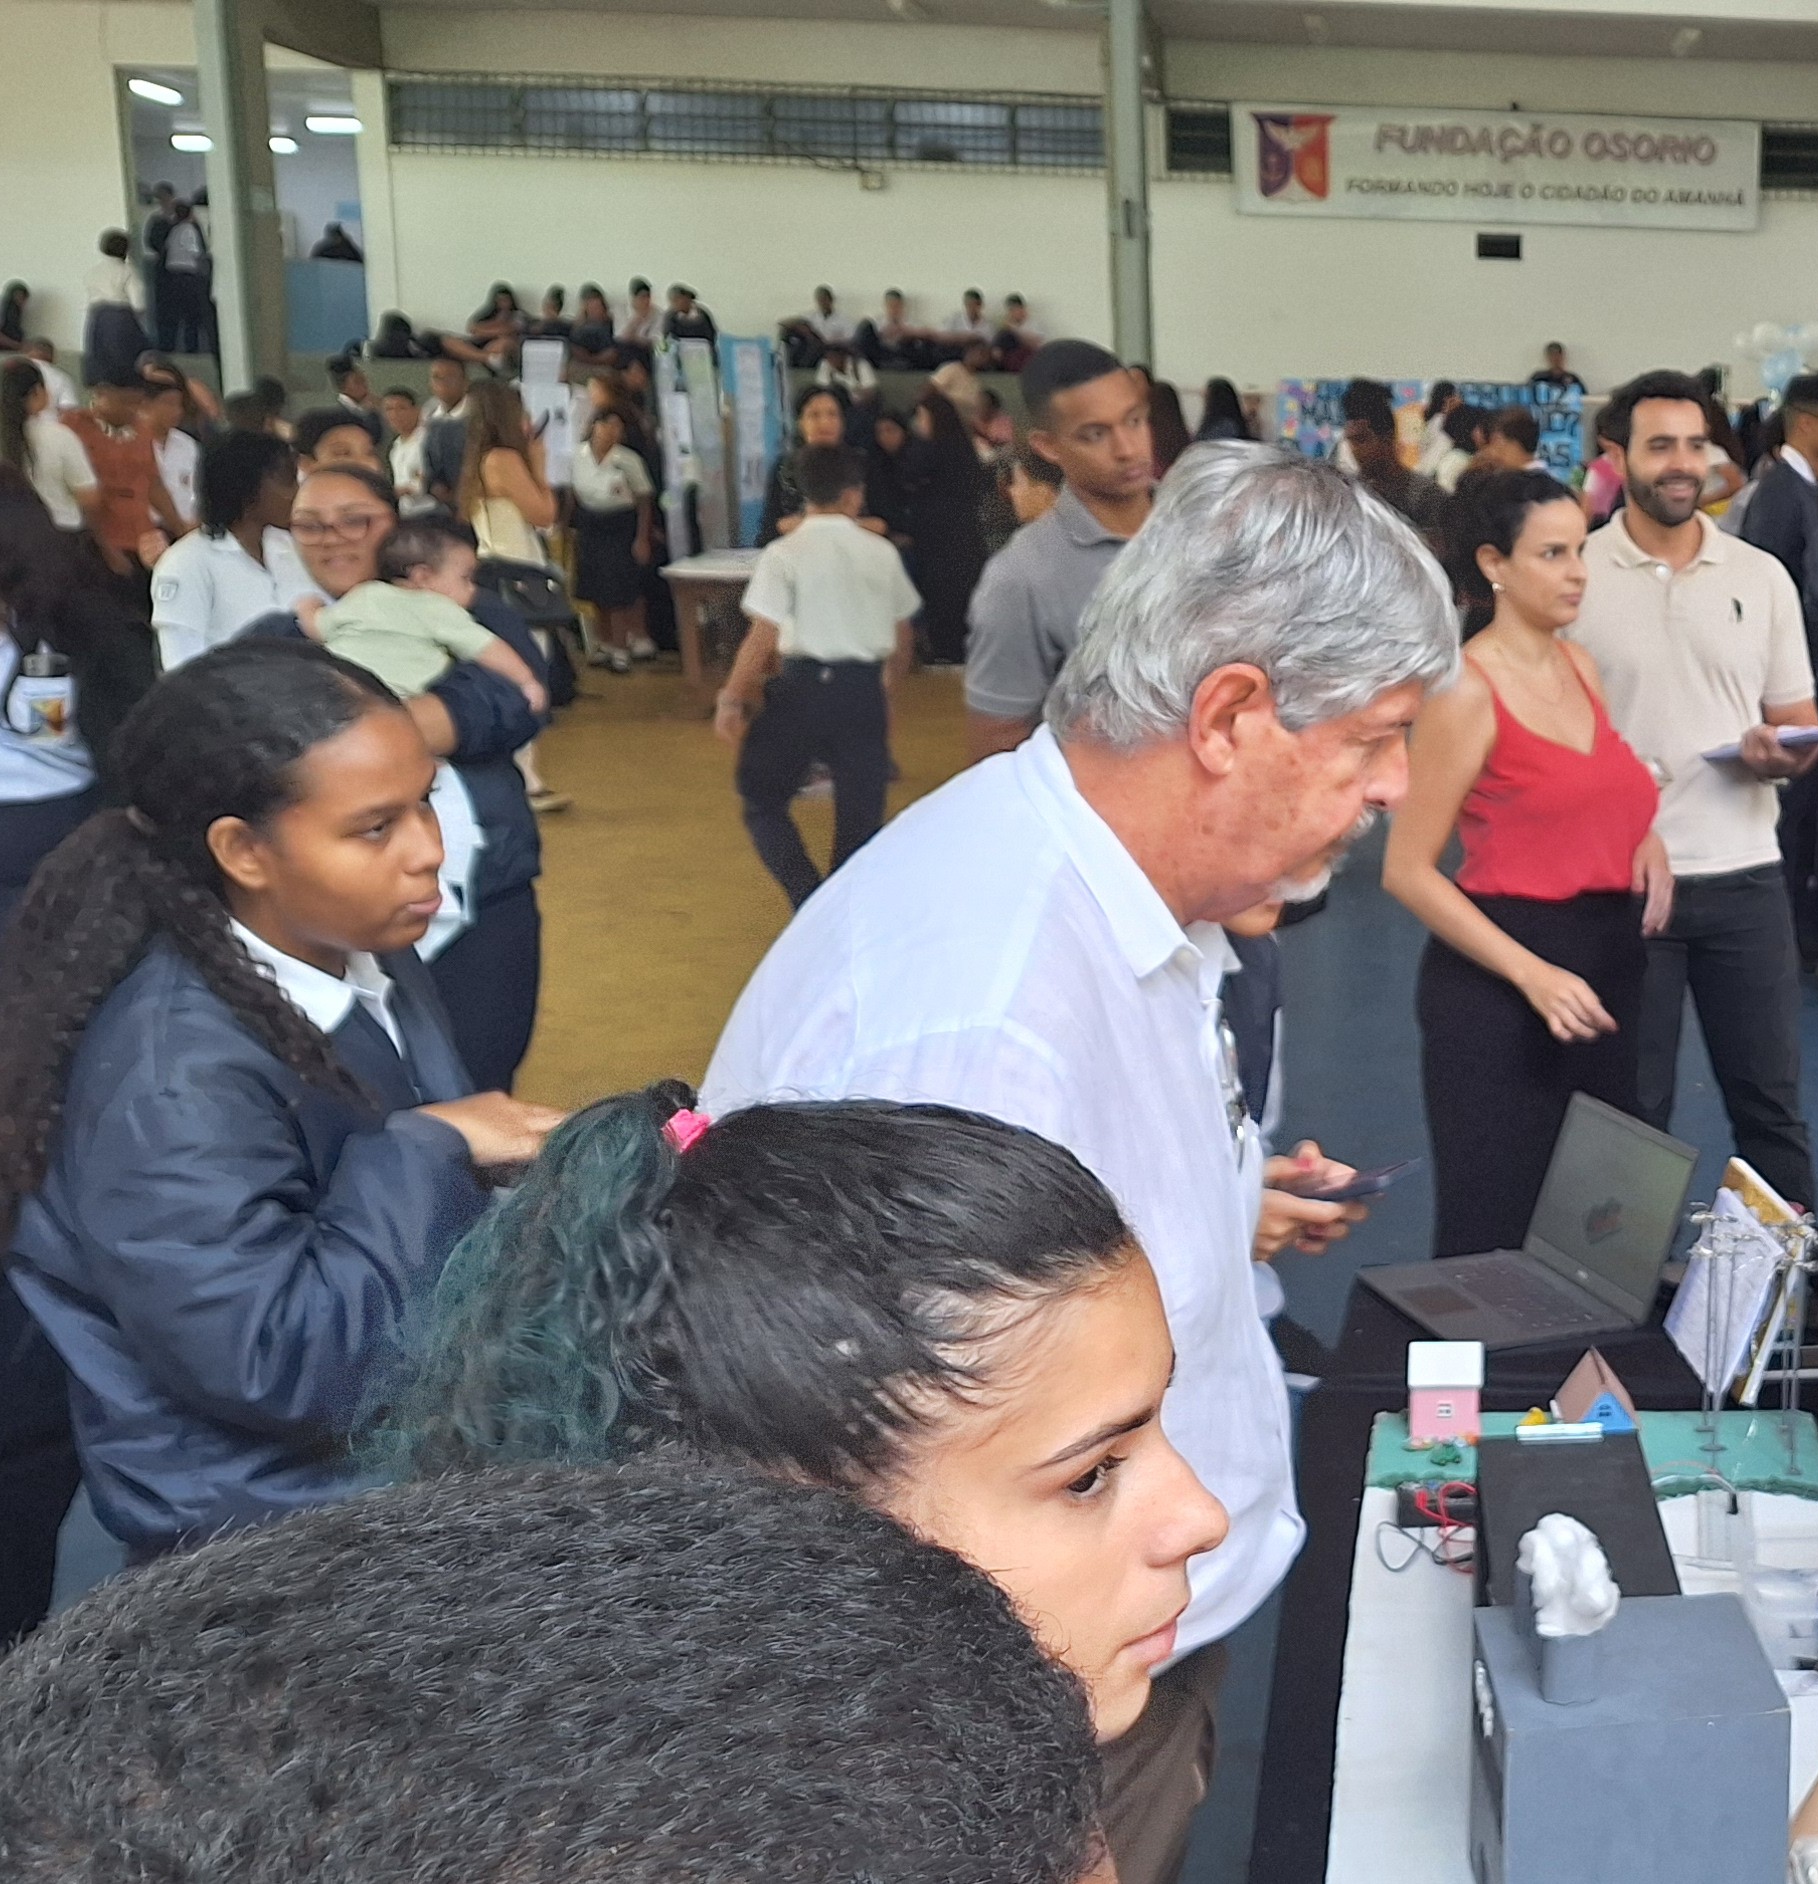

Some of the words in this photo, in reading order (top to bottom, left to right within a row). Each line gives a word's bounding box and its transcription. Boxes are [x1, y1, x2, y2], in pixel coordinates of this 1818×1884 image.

[1374, 122, 1572, 164] FUNDAÇÃO
[1583, 130, 1717, 166] OSORIO
[1346, 178, 1460, 197] FORMANDO
[1464, 182, 1512, 200] HOJE
[1519, 183, 1536, 200] O
[1540, 184, 1628, 204] CIDADÃO
[1631, 188, 1658, 204] DO
